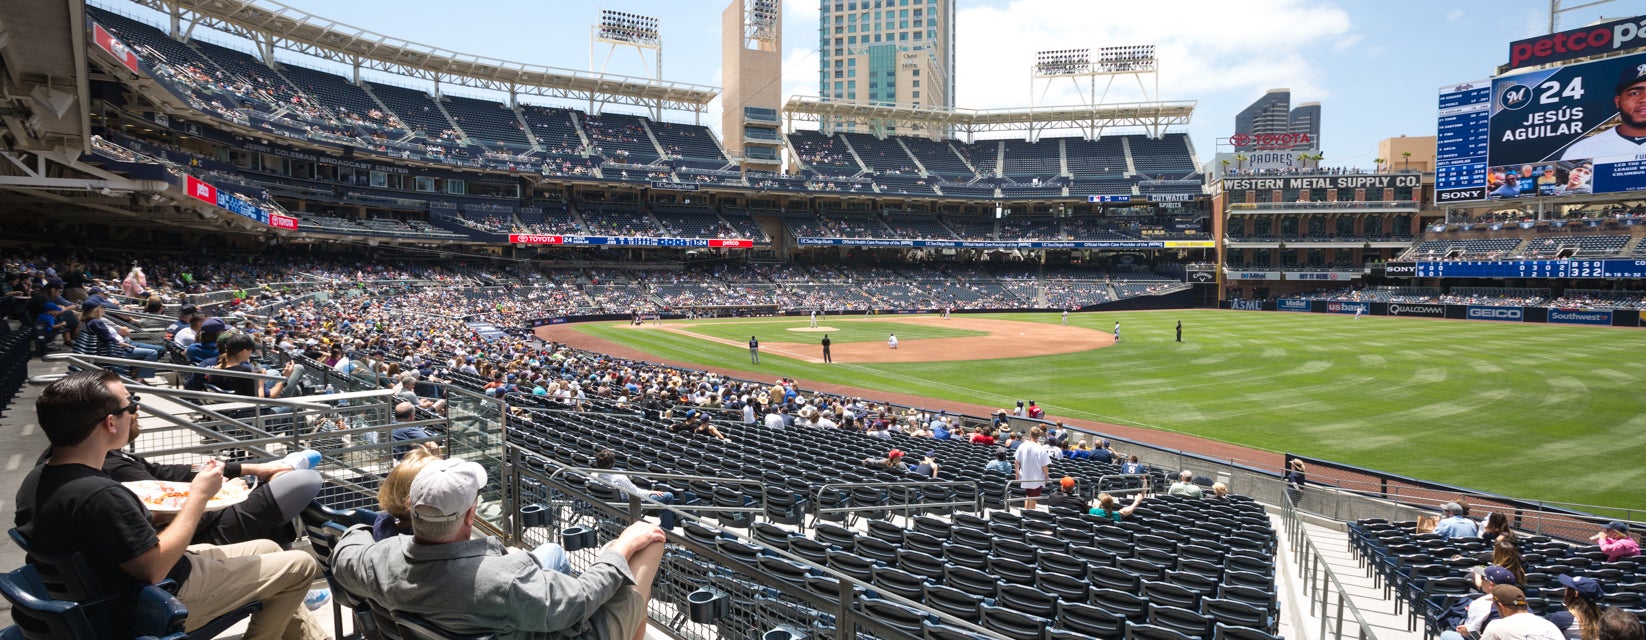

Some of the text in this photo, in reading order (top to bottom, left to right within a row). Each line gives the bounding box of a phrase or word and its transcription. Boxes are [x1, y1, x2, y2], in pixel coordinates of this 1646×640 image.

[1539, 76, 1585, 105] 24
[1523, 106, 1584, 126] JESÚS
[1502, 123, 1584, 142] AGUILAR
[1254, 133, 1311, 145] TOYOTA
[243, 143, 409, 175] JERRY COLEMAN BROADCAST CENTER
[1249, 151, 1293, 167] PADRES
[1223, 177, 1284, 192] WESTERN
[1290, 177, 1335, 190] METAL
[1338, 177, 1390, 188] SUPPLY
[1396, 176, 1420, 187] CO.
[1441, 190, 1482, 200] SONY
[1571, 268, 1601, 276] 3 2 2
[1231, 300, 1262, 311] ASML
[1390, 304, 1444, 316] QUALCOMM
[1469, 308, 1521, 318] GEICO
[1551, 312, 1601, 322] Southwest
